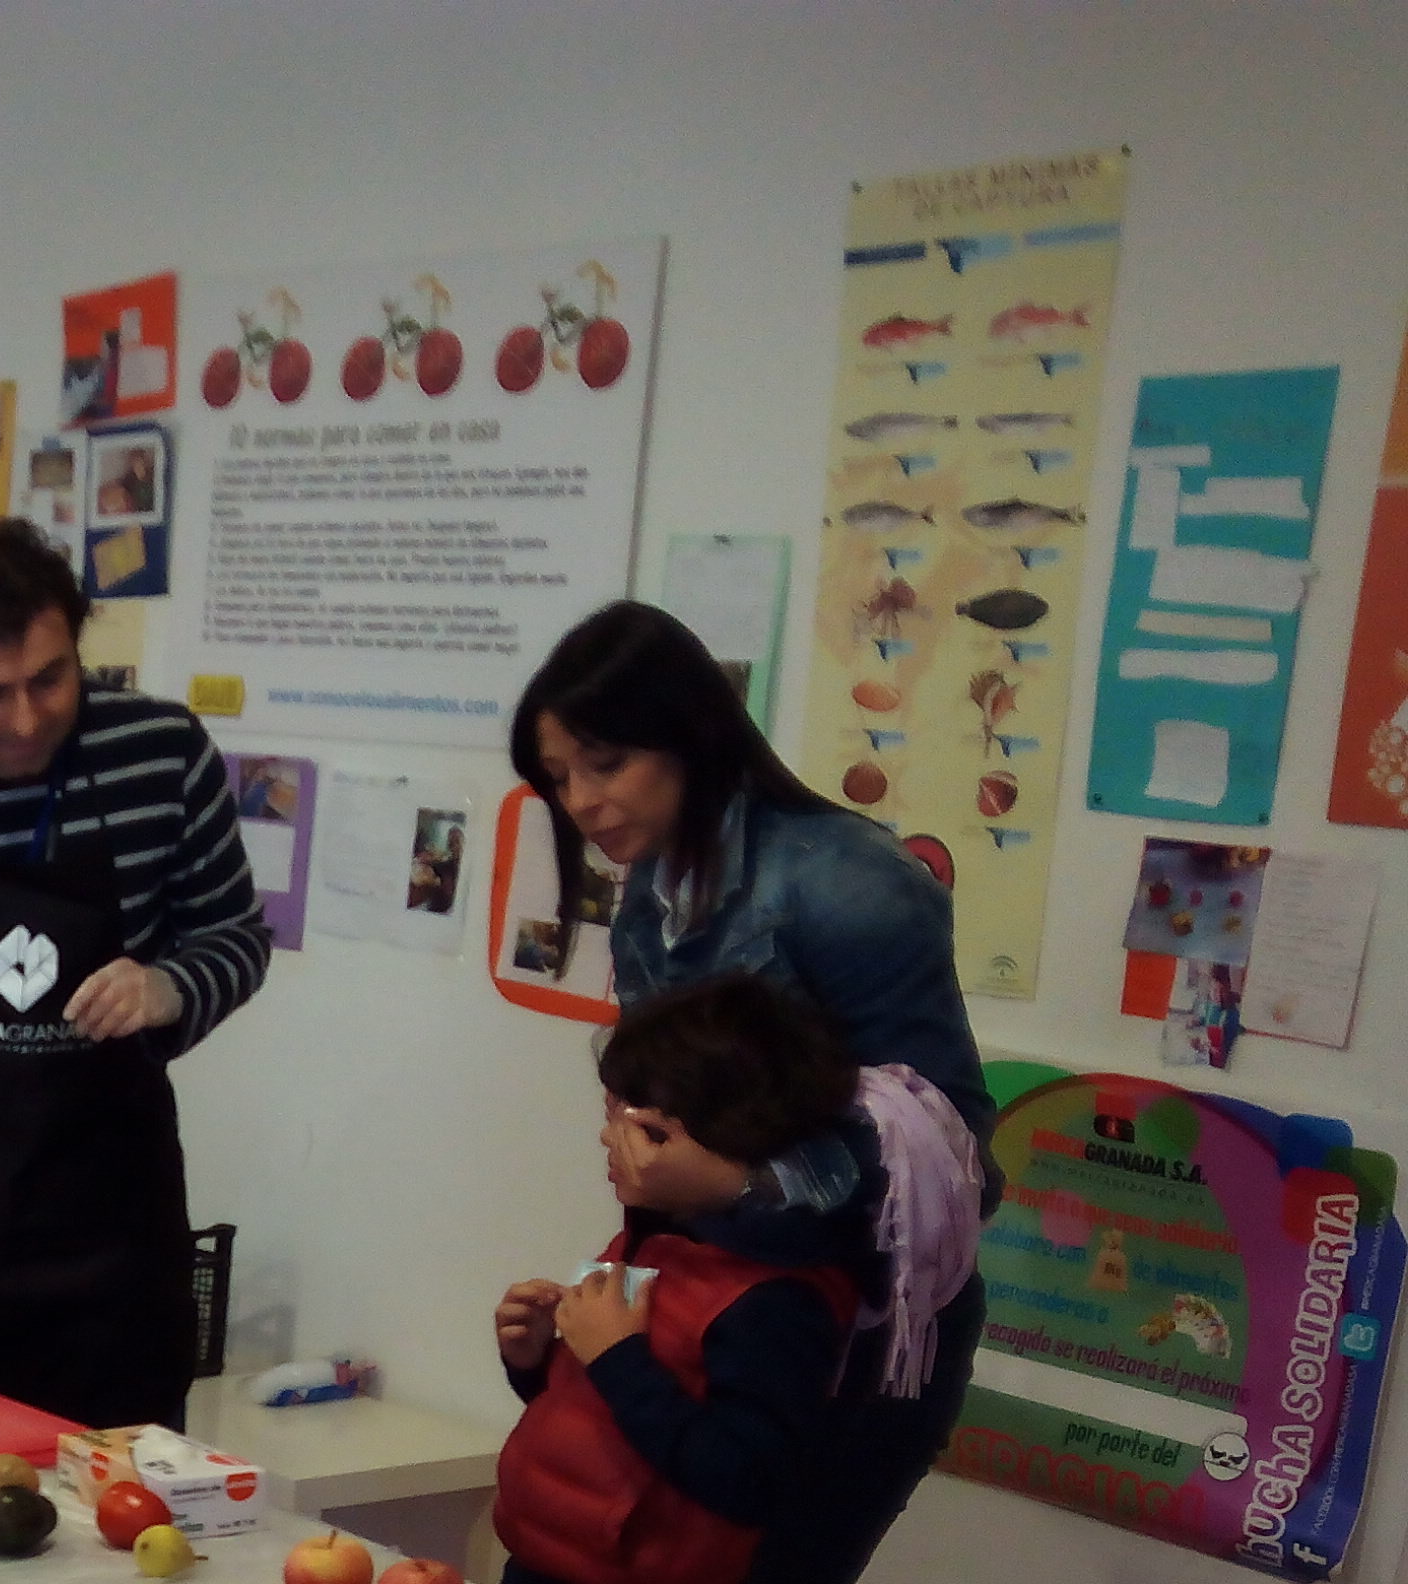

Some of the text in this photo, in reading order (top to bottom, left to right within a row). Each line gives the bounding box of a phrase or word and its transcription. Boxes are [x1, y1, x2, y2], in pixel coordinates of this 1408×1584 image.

[1281, 1192, 1360, 1422] SOLIDARIA
[1076, 1342, 1160, 1381] realizará
[1064, 1421, 1183, 1467] por parte del
